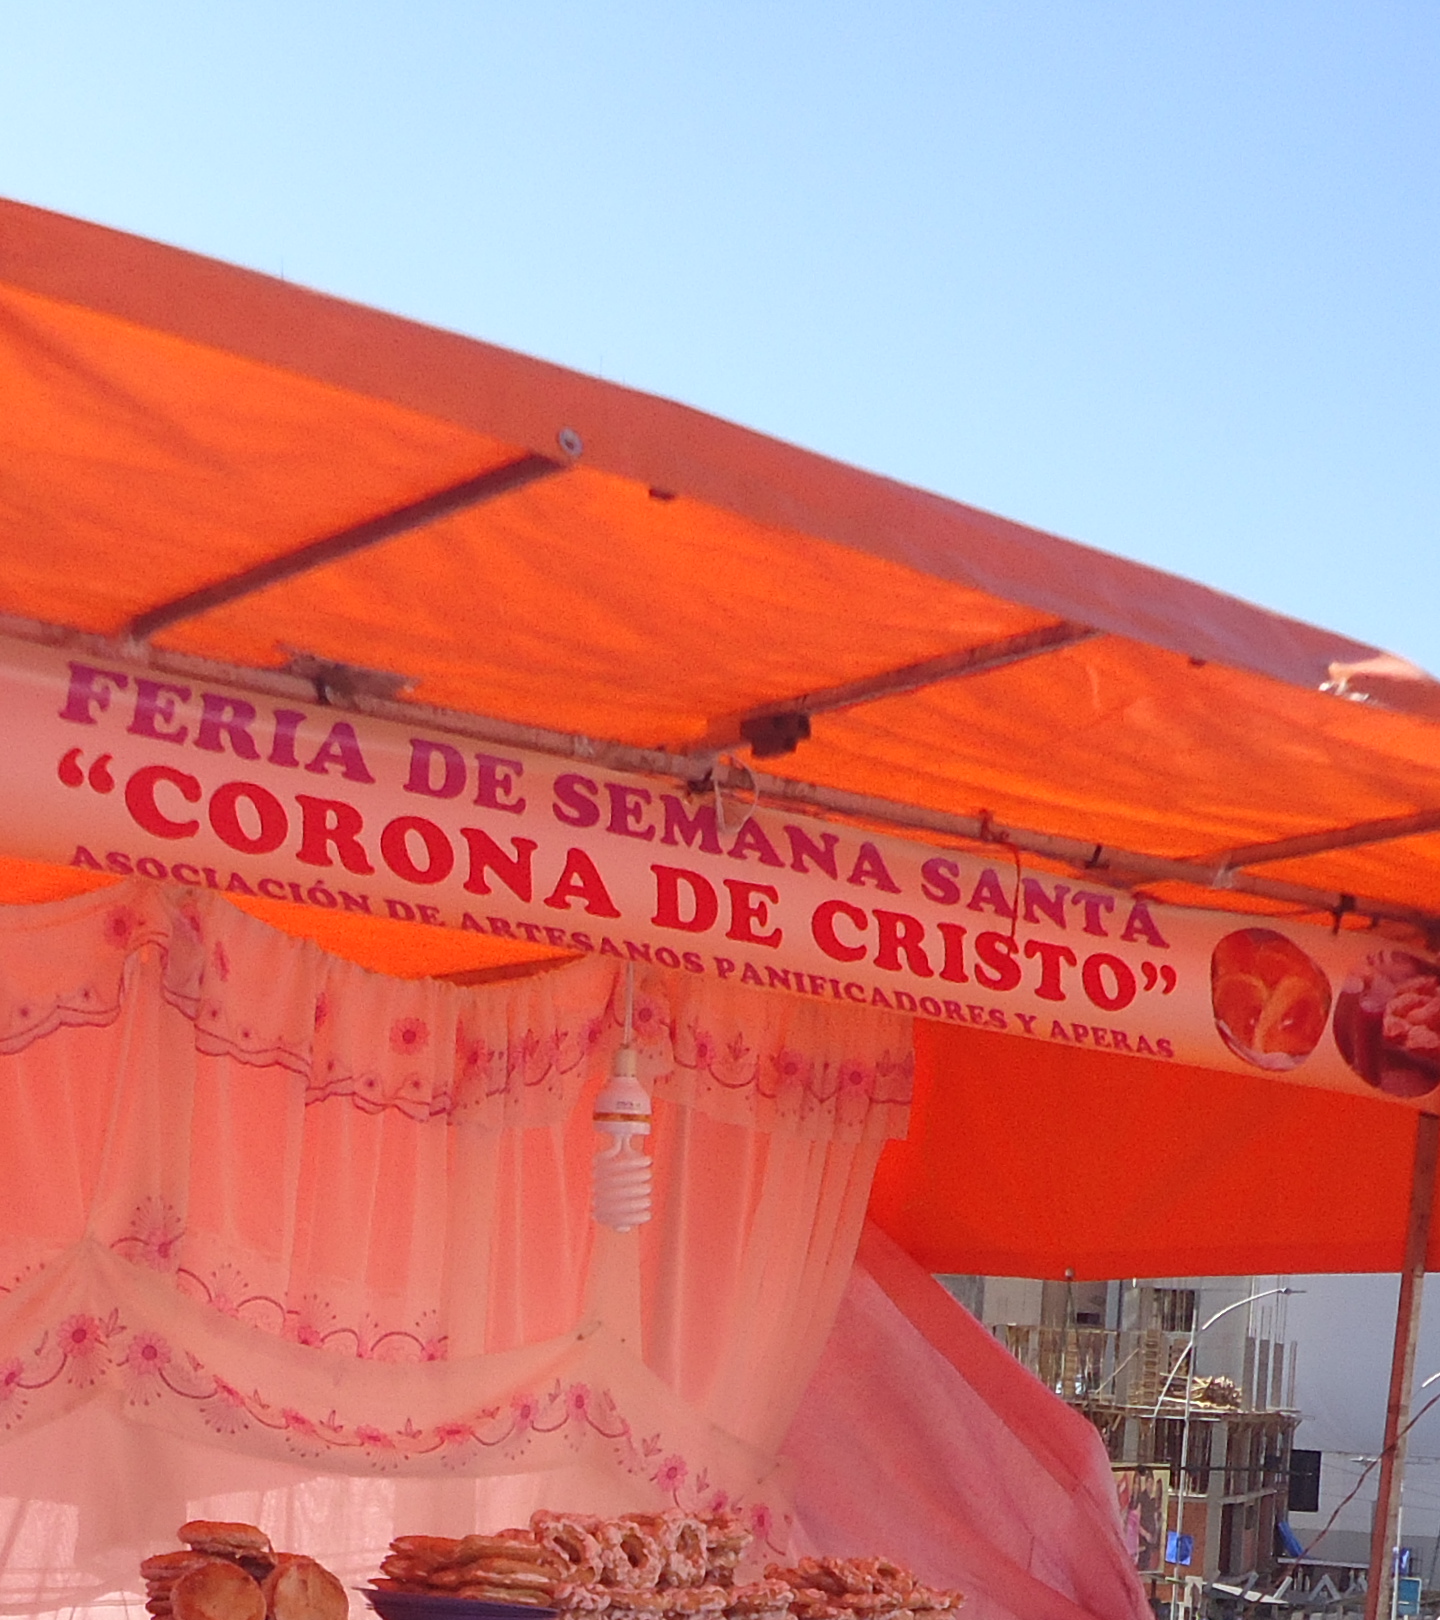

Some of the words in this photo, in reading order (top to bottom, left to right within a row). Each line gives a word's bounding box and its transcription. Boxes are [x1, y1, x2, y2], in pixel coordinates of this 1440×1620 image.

[56, 746, 622, 919] “CORONA
[649, 863, 783, 949] DE
[811, 899, 1177, 1012] CRISTO”
[58, 660, 376, 785] FERIA
[402, 737, 527, 815] DE
[552, 772, 902, 895] SEMANA
[920, 856, 1171, 949] SANTA
[70, 844, 371, 916] ASOCIACIÓN
[384, 897, 446, 927] DE
[460, 911, 706, 974] ARTESANOS
[713, 956, 1008, 1031] PANIFICADORES
[1014, 1012, 1038, 1037] Y
[1049, 1019, 1175, 1060] APERAS
